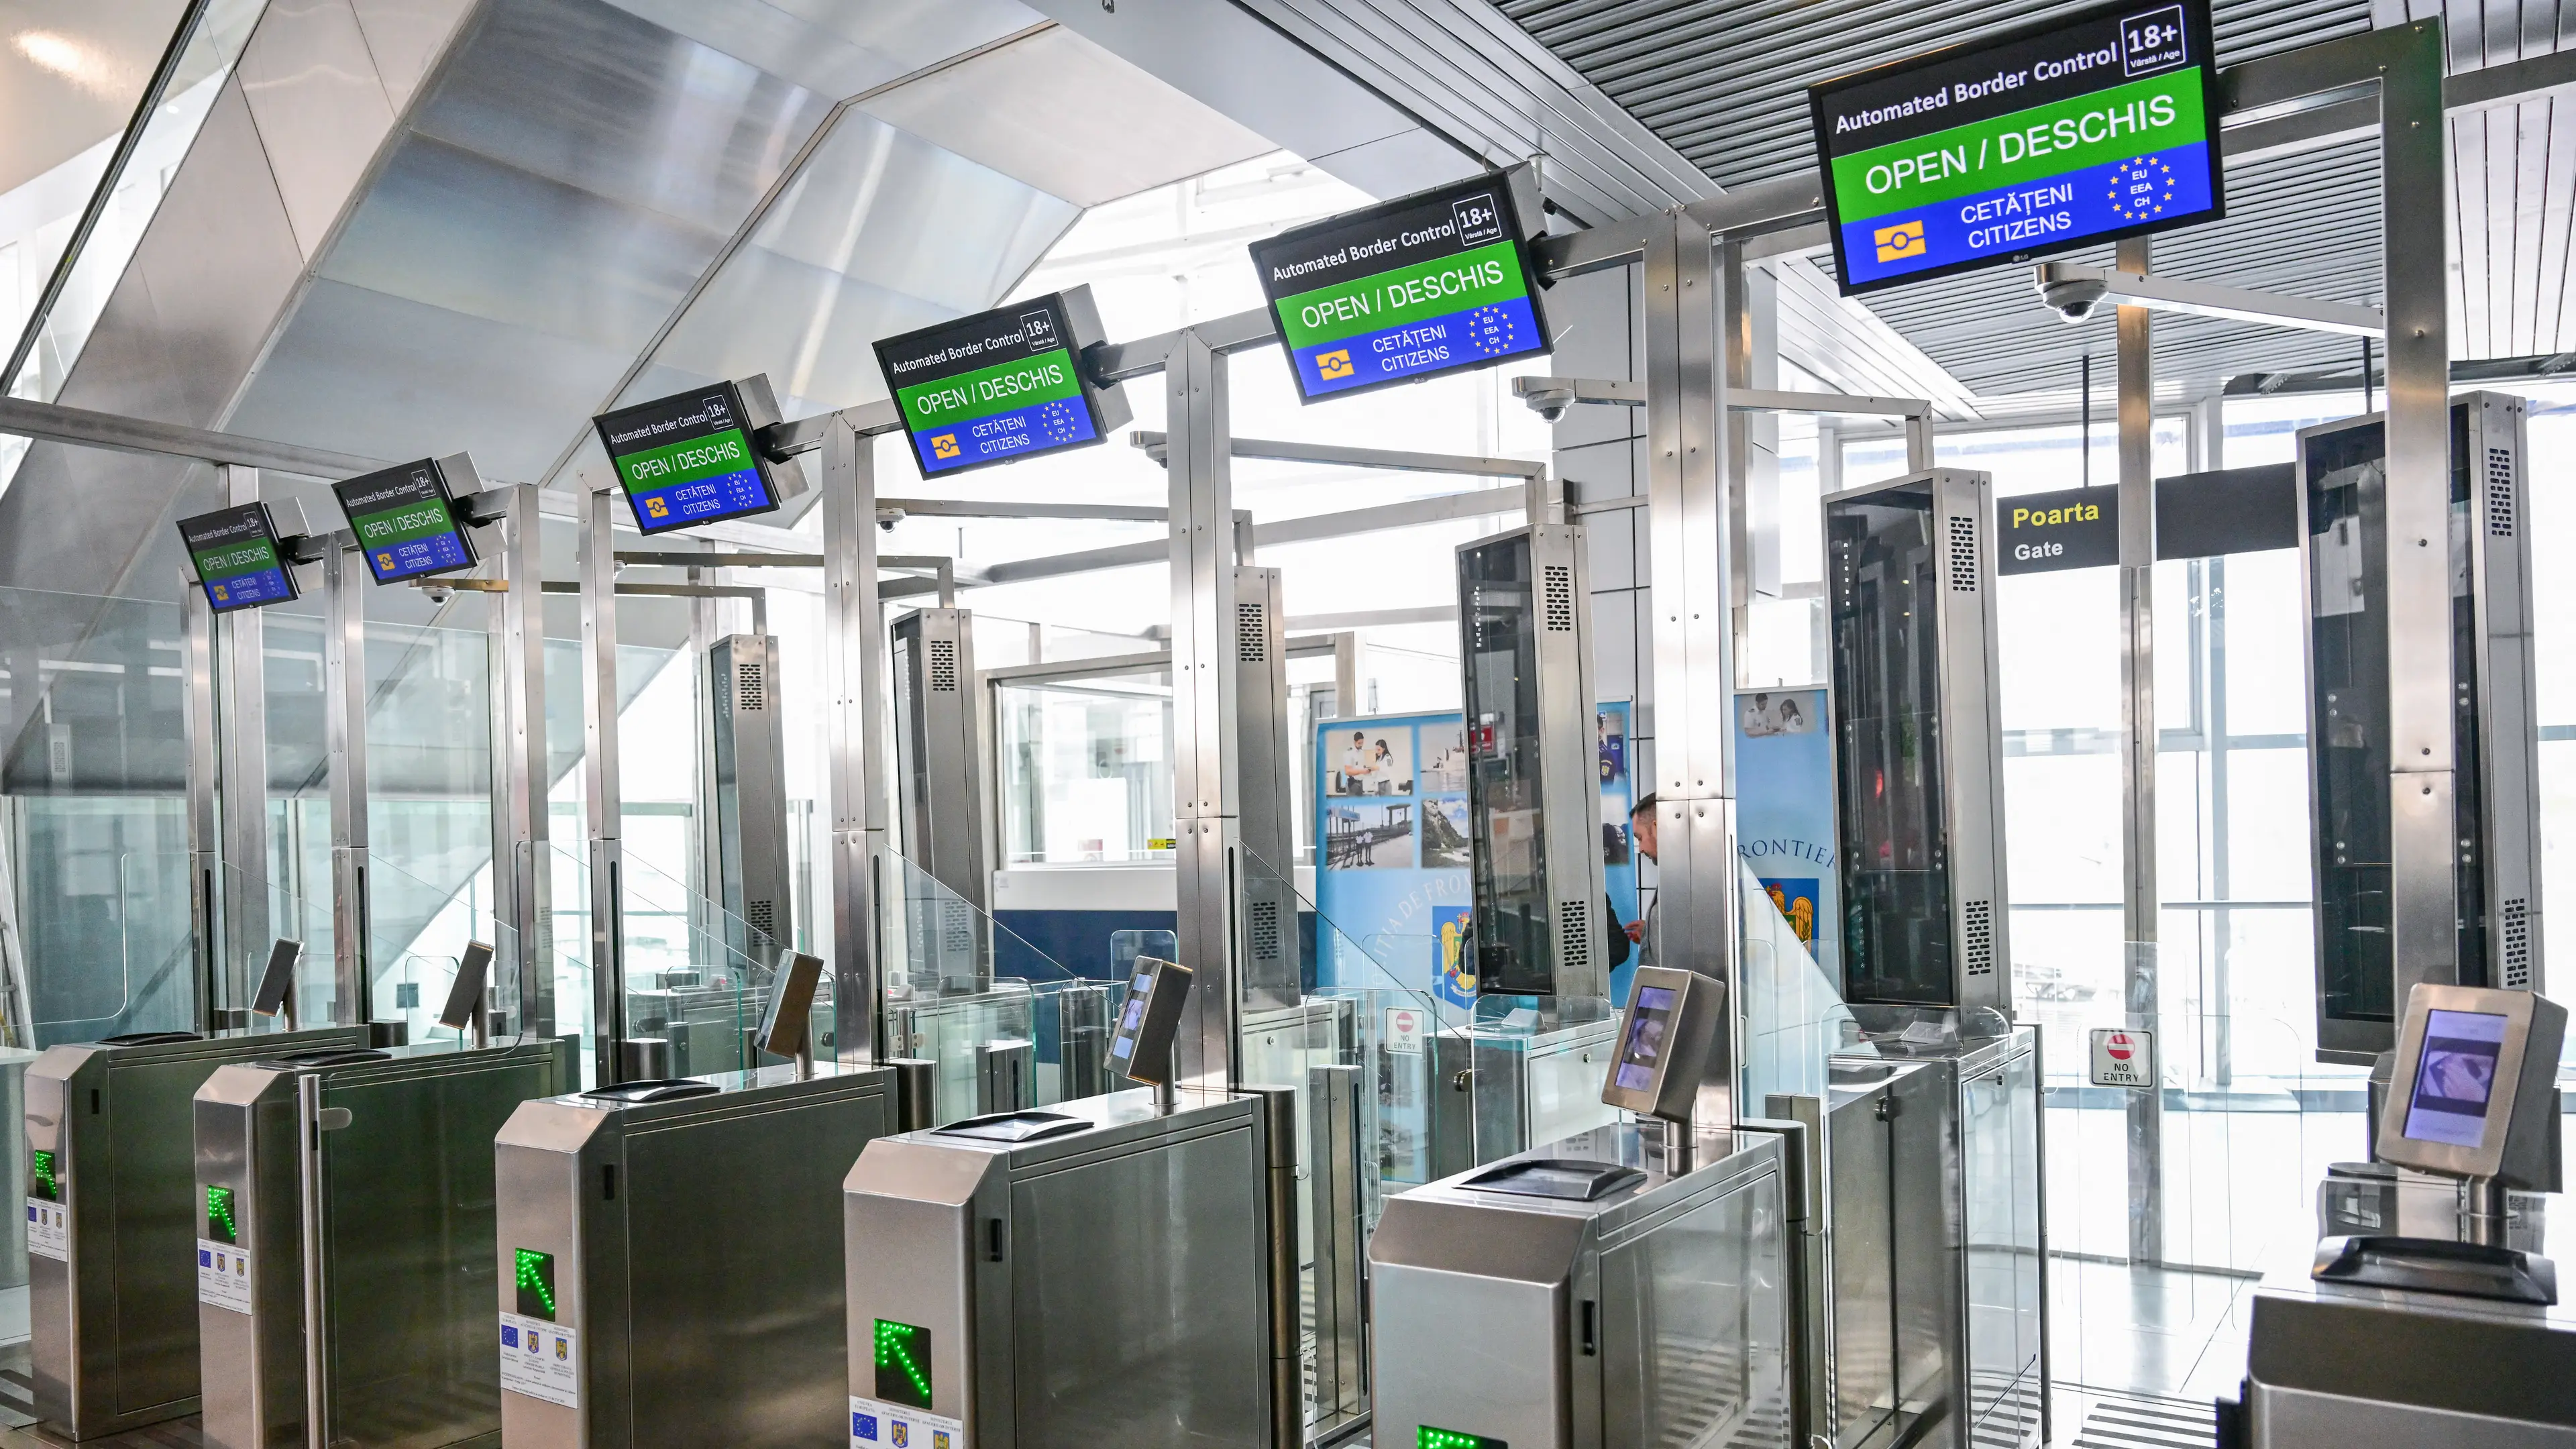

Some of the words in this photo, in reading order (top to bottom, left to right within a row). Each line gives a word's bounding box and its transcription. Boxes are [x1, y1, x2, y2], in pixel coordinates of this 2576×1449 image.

[2129, 25, 2177, 52] 18+
[2163, 51, 2180, 60] Age
[1836, 87, 1947, 134] Automated
[1955, 71, 2027, 102] Border
[2034, 42, 2116, 80] Control
[1866, 146, 1966, 193] OPEN
[1979, 139, 1987, 169] /
[1999, 95, 2175, 164] DESCHIS
[2132, 169, 2147, 180] EU
[2131, 182, 2153, 194] EEA
[2135, 197, 2150, 207] CH
[1460, 208, 1492, 228] 18+
[1968, 212, 2071, 248] CITIZENS
[1275, 249, 1347, 281] Automated
[1350, 239, 1397, 260] Border
[1401, 219, 1455, 246] Control
[1302, 293, 1370, 327] OPEN
[1377, 289, 1381, 312] /
[1387, 261, 1503, 308] DESCHIS
[1026, 321, 1049, 337] 18+
[1484, 326, 1499, 334] EEA
[894, 350, 947, 374] Automated
[948, 343, 982, 360] Border
[985, 329, 1024, 350] Control
[1382, 346, 1449, 371] CITIZENS
[918, 387, 968, 414] OPEN
[971, 384, 975, 403] /
[979, 365, 1063, 400] DESCHIS
[708, 405, 725, 417] 18+
[611, 425, 651, 444] Automated
[651, 420, 677, 433] Border
[678, 411, 708, 427] Control
[981, 434, 1029, 453] CITIZENS
[632, 458, 670, 479] OPEN
[672, 455, 676, 472] /
[677, 441, 740, 470] DESCHIS
[416, 477, 429, 487] 18+
[346, 492, 376, 507] Automated
[376, 489, 394, 500] Border
[395, 482, 417, 495] Control
[684, 499, 720, 515] CITIZENS
[2014, 502, 2098, 528] Poarta
[247, 518, 258, 527] 18+
[364, 520, 393, 537] OPEN
[393, 519, 397, 532] /
[397, 508, 443, 530] DESCHIS
[189, 530, 213, 543] Automated
[213, 527, 229, 537] Border
[229, 523, 248, 533] Control
[203, 555, 227, 570] OPEN
[227, 554, 231, 566] /
[231, 547, 269, 565] DESCHIS
[2015, 541, 2063, 560] Gate
[405, 556, 432, 568] CITIZENS
[237, 589, 260, 600] CITIZENS
[1737, 839, 1835, 869] RONTIE
[1398, 891, 1423, 920] DE
[2114, 1063, 2129, 1071] NO
[2104, 1073, 2139, 1082] ENTRY
